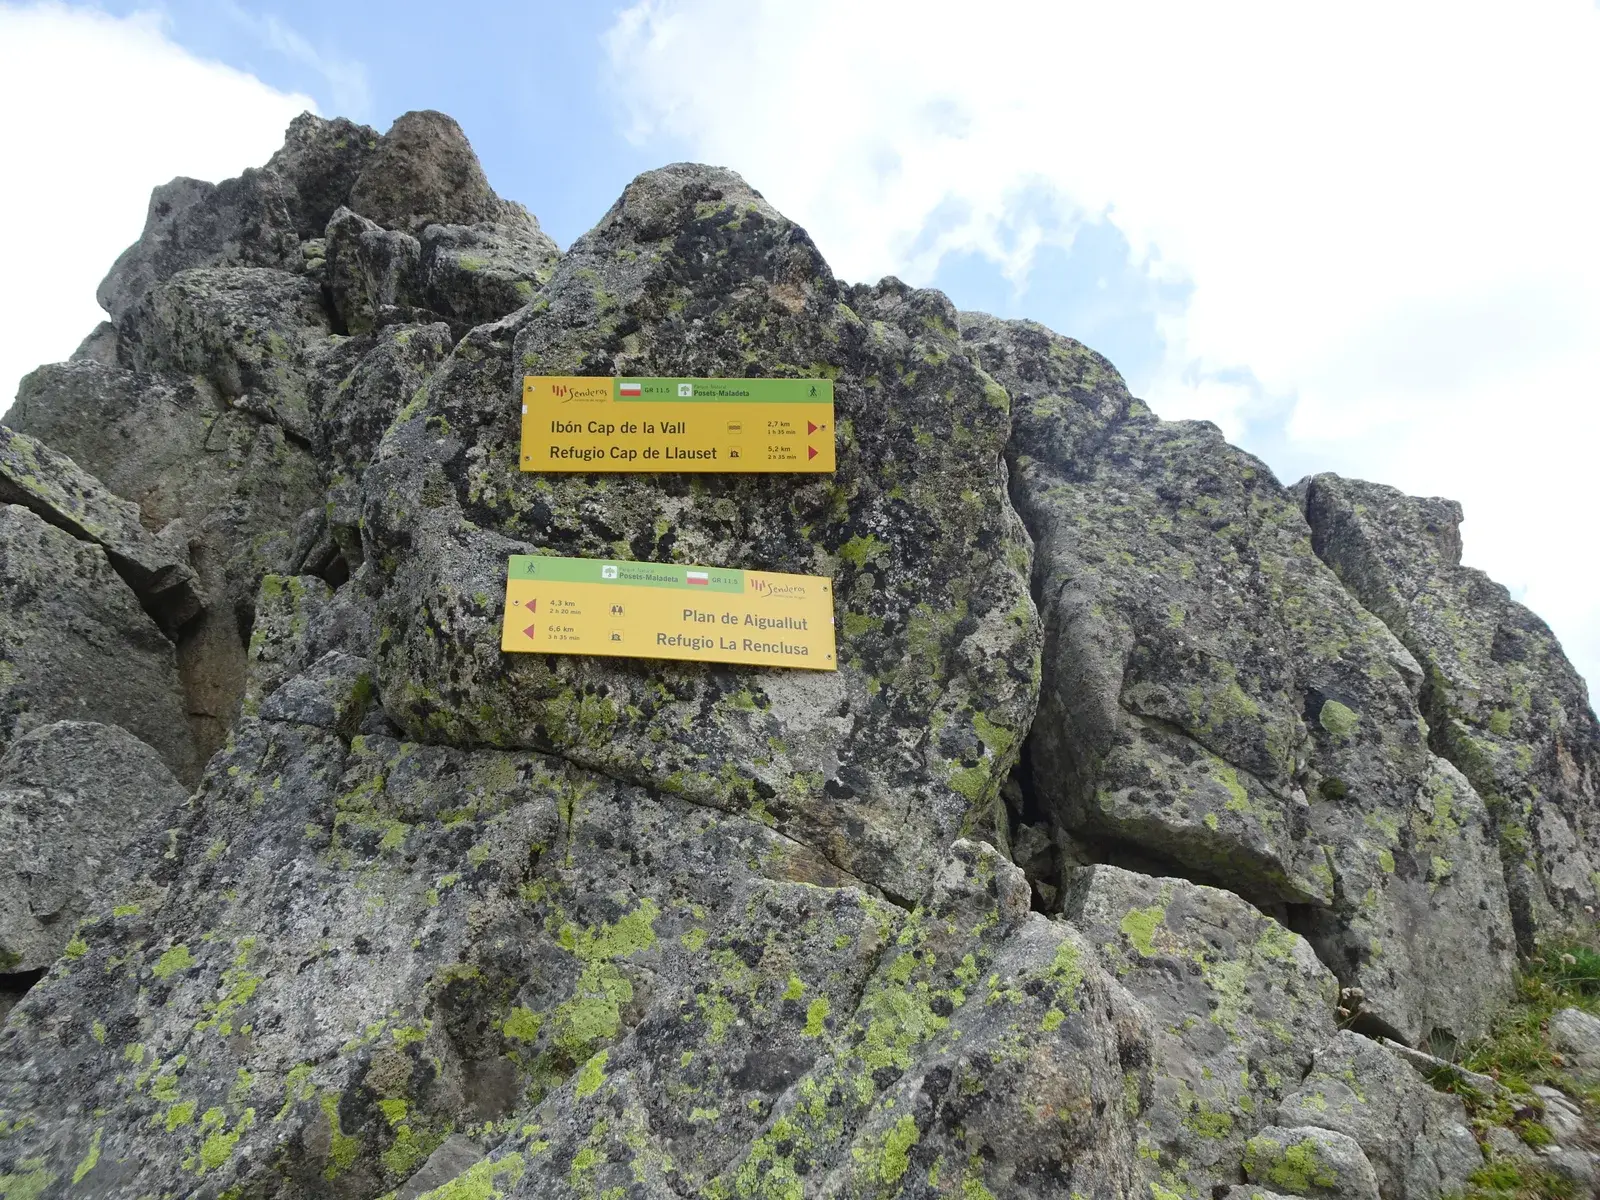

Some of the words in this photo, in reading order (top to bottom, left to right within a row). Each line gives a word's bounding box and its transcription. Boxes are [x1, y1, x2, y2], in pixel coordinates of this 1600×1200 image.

[562, 388, 607, 403] Senderos
[693, 389, 750, 397] Posets-Maladeta
[551, 420, 581, 433] Ibón
[588, 421, 615, 436] Cap
[620, 422, 637, 433] de
[643, 422, 655, 433] la
[660, 422, 685, 434] Vall
[550, 446, 605, 461] Refugio
[610, 446, 637, 461] Cap
[643, 447, 660, 459] de
[666, 447, 717, 459] Llauset
[619, 572, 678, 583] Posets-Maladeta
[761, 583, 805, 598] Senderos
[683, 609, 715, 623] Plan
[721, 612, 738, 625] de
[744, 614, 808, 631] Aiguallut
[657, 633, 714, 650] Refugio
[720, 637, 737, 650] La
[743, 639, 809, 655] Renclusa
